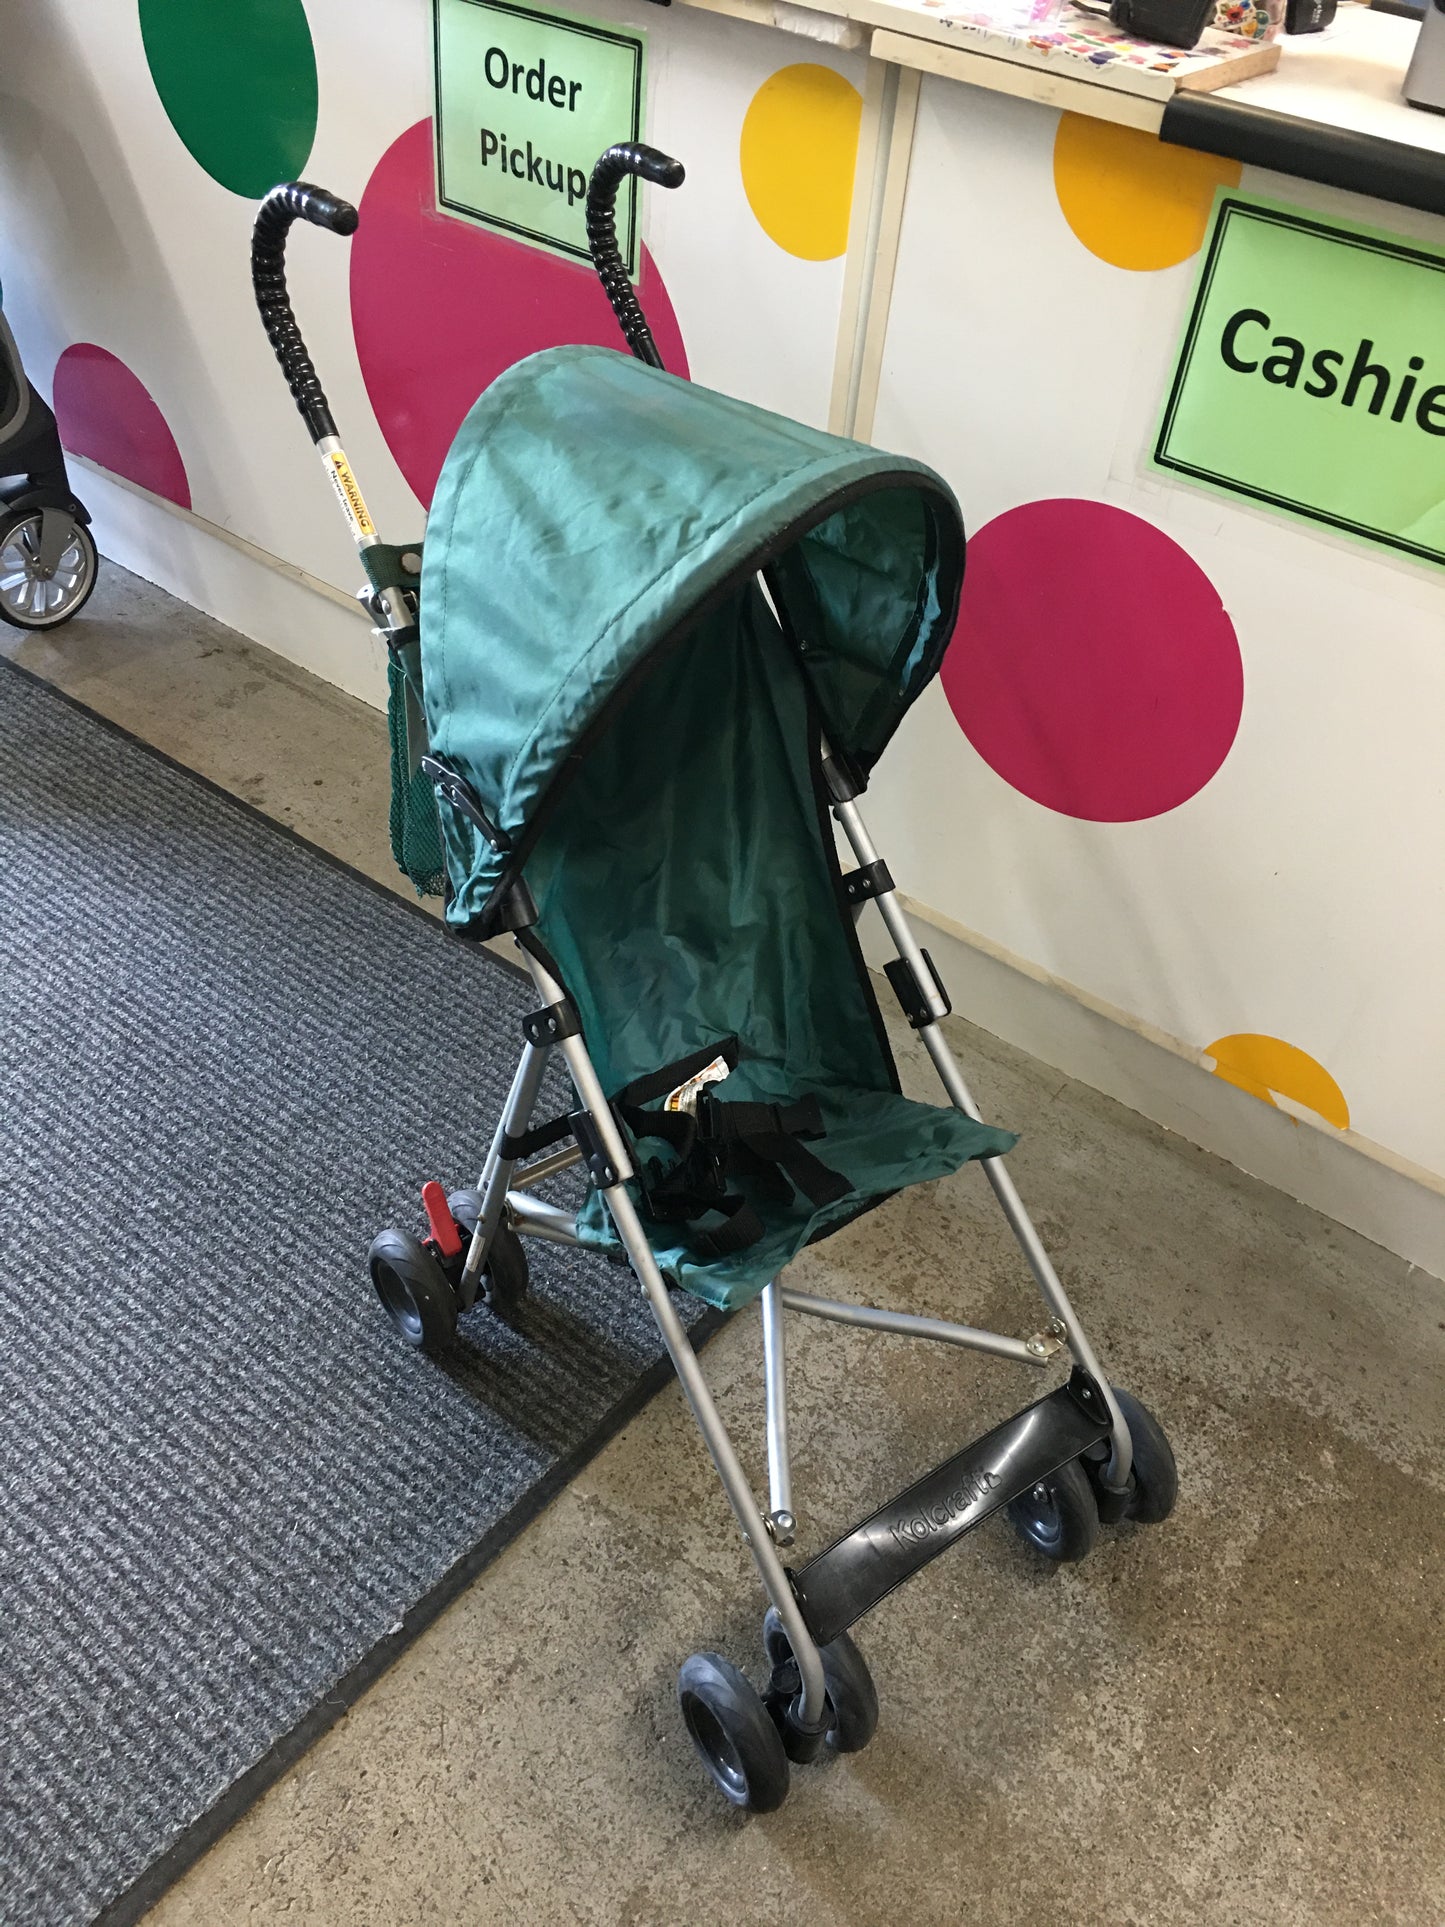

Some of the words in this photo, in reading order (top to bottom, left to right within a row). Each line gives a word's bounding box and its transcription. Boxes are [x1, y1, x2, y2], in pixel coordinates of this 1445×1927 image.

[485, 47, 582, 111] Order
[481, 128, 587, 206] Pickup
[331, 470, 344, 497] Never
[342, 498, 354, 522] leave
[341, 472, 370, 528] WARNING
[889, 1467, 989, 1551] Kolcraft
